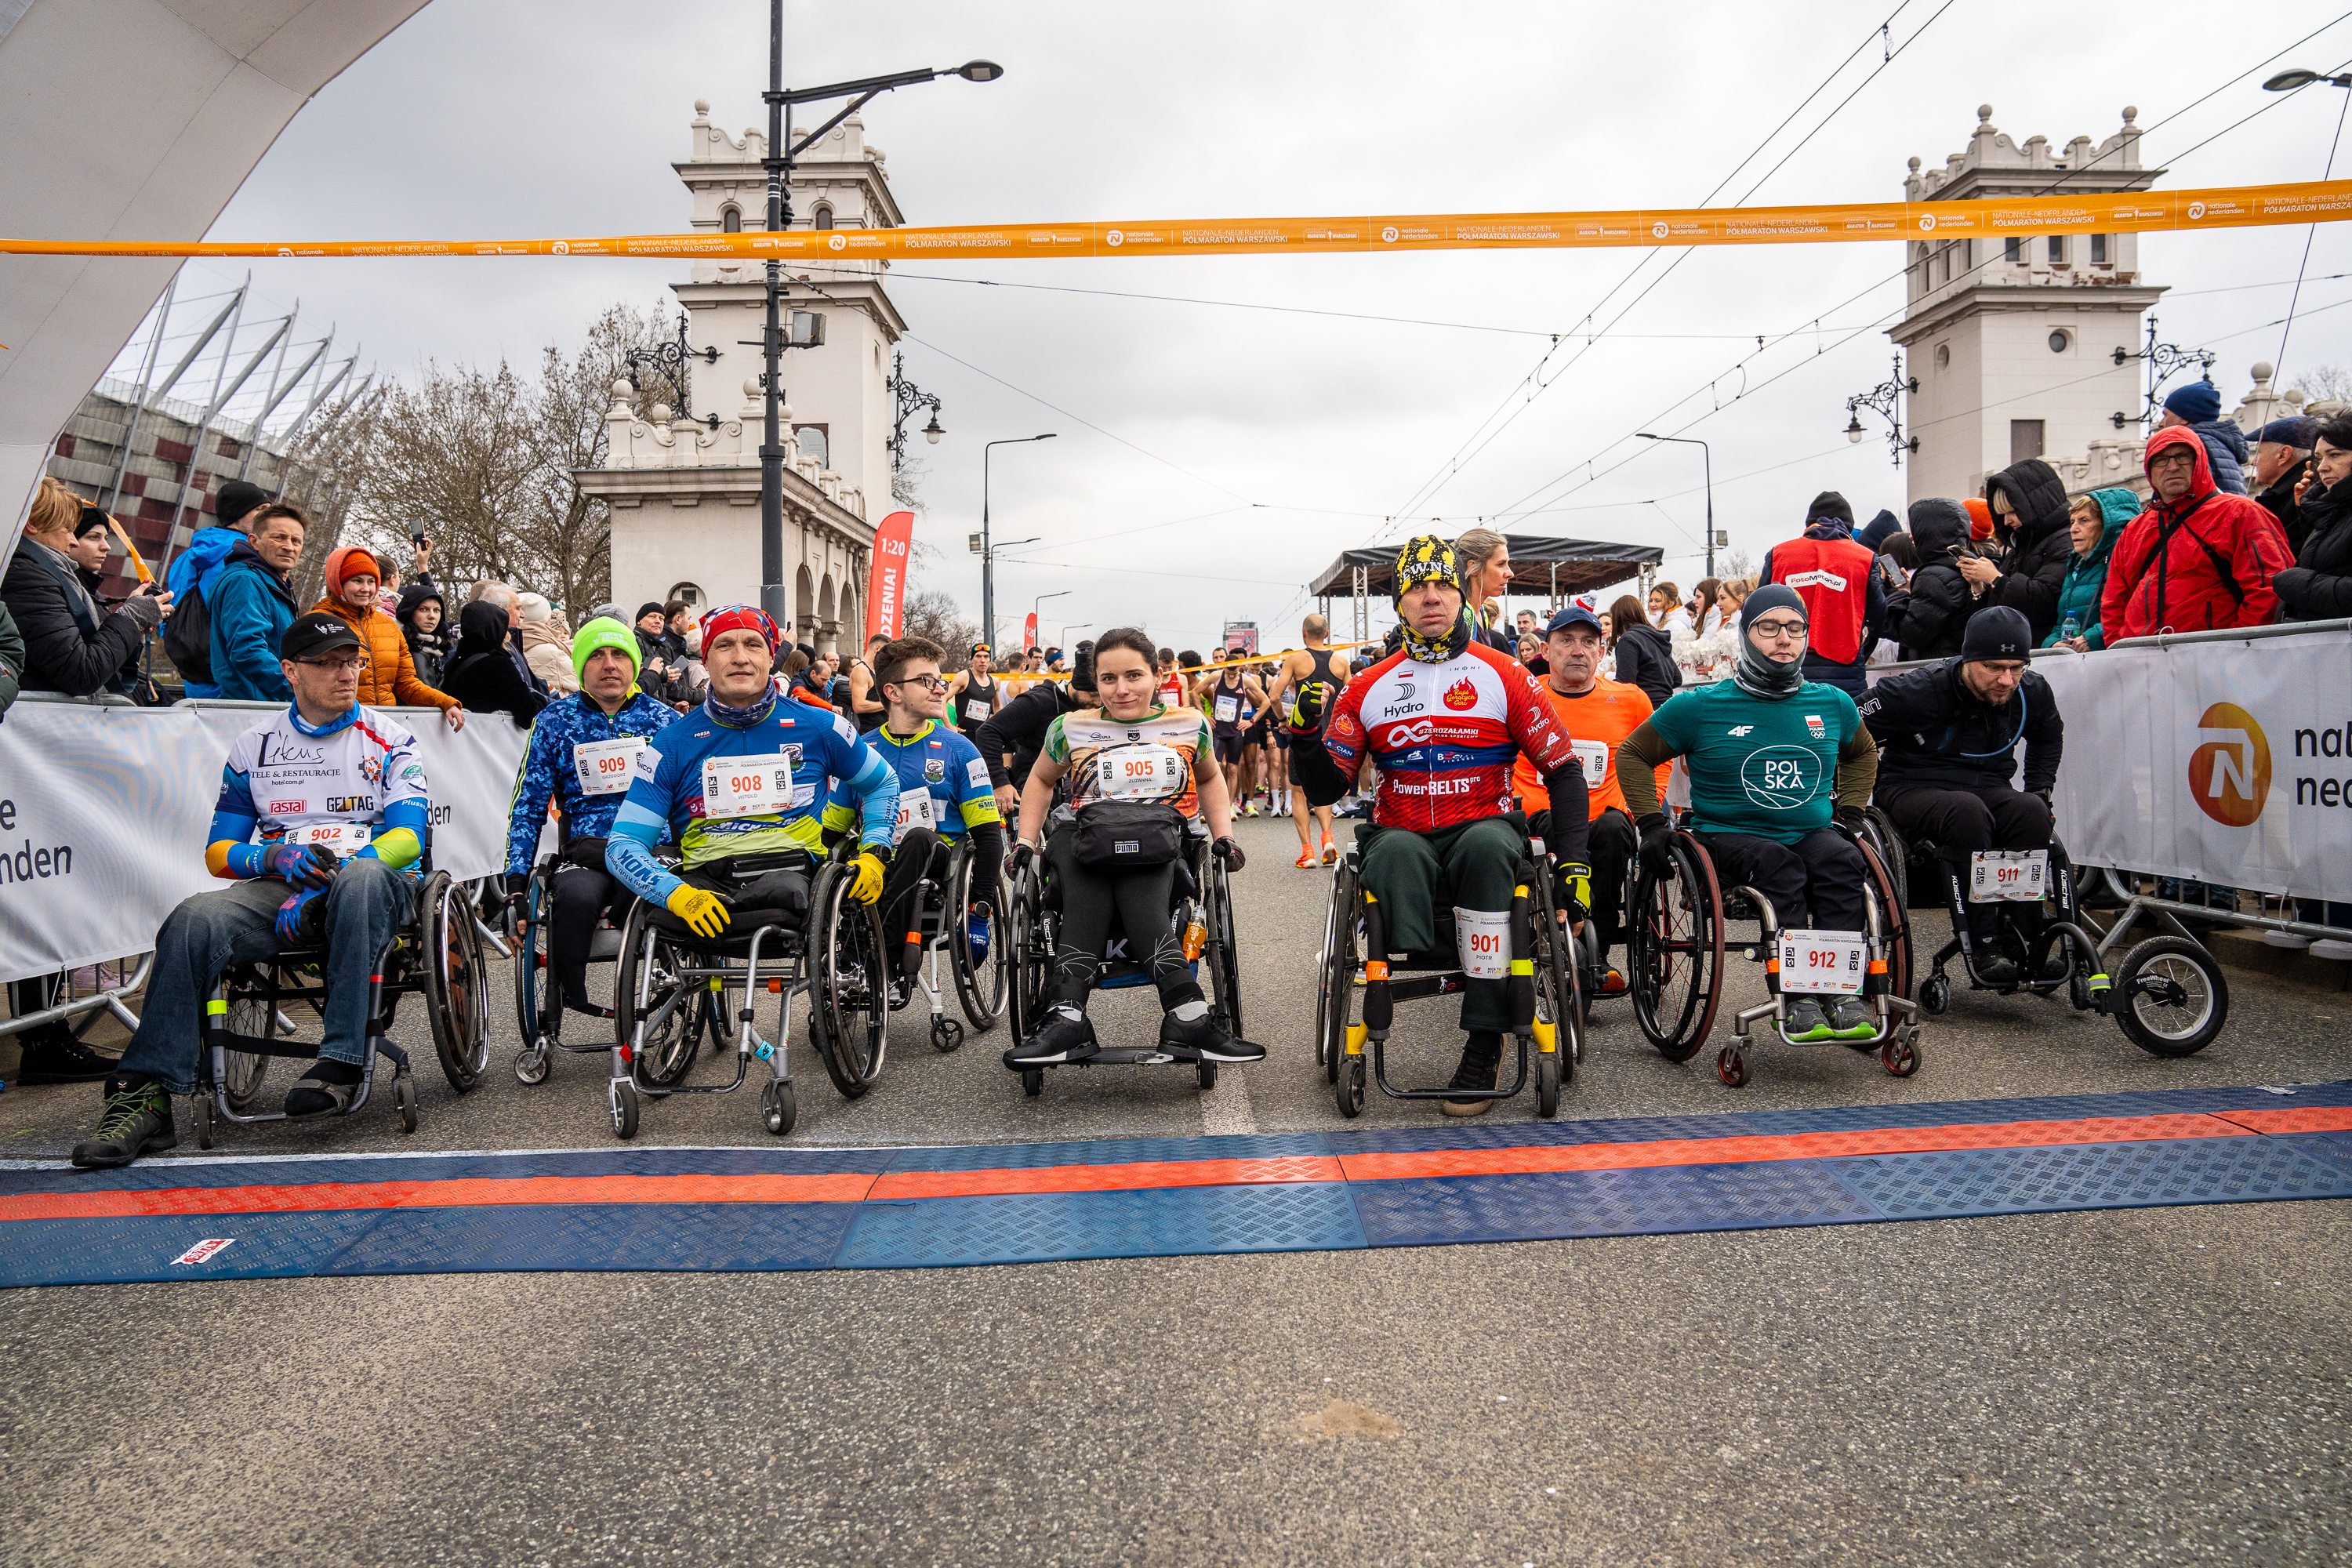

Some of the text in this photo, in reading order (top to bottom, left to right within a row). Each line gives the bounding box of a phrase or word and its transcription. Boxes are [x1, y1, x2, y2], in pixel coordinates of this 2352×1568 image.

[1992, 209, 2086, 220] NATIONALE-NEDERLANDEN
[2207, 207, 2245, 216] nederlanden
[1726, 219, 1820, 229] NATIONALE-NEDERLANDEN
[1993, 216, 2096, 228] PÓŁMARATON WARSZAWSKI
[1182, 229, 1279, 238] NATIONALE-NEDERLANDEN
[1456, 225, 1552, 234] NATIONALE-NEDERLANDEN
[1726, 225, 1777, 235] PÓŁMARATON
[905, 232, 1003, 241] NATIONALE-NEDERLANDEN
[1182, 234, 1289, 245] PÓŁMARATON WARSZAWSKI
[1457, 231, 1561, 241] PÓŁMARATON WARSZAWSKI
[627, 238, 725, 247] NATIONALE-NEDERLANDEN
[848, 240, 887, 249] nederlanden
[906, 238, 1012, 249] PÓŁMARATON WARSZAWSKI
[296, 248, 324, 256] nationale
[351, 244, 449, 255] NATIONALE-NEDERLANDEN
[628, 244, 735, 254] PÓŁMARATON WARSZAWSKI
[882, 537, 906, 557] 1:20
[1385, 702, 1425, 718] Hydro
[1527, 717, 1550, 736] Hydro
[1727, 725, 1755, 737] 4F
[600, 757, 626, 774] 909
[1125, 760, 1154, 777] 905
[1766, 760, 1803, 775] POL
[281, 768, 341, 779] RESTAURACJE
[731, 775, 762, 793] 908
[1469, 775, 1481, 785] pro
[1764, 775, 1806, 789] SKA
[271, 800, 306, 814] rastal
[326, 796, 375, 813] GELTAG
[312, 829, 342, 842] 902
[1116, 844, 1138, 853] PUMA
[1998, 868, 2020, 883] 911
[1105, 938, 1128, 959] K
[1471, 933, 1499, 953] 901
[1809, 950, 1836, 968] 912
[2136, 975, 2169, 985] FreeWheel
